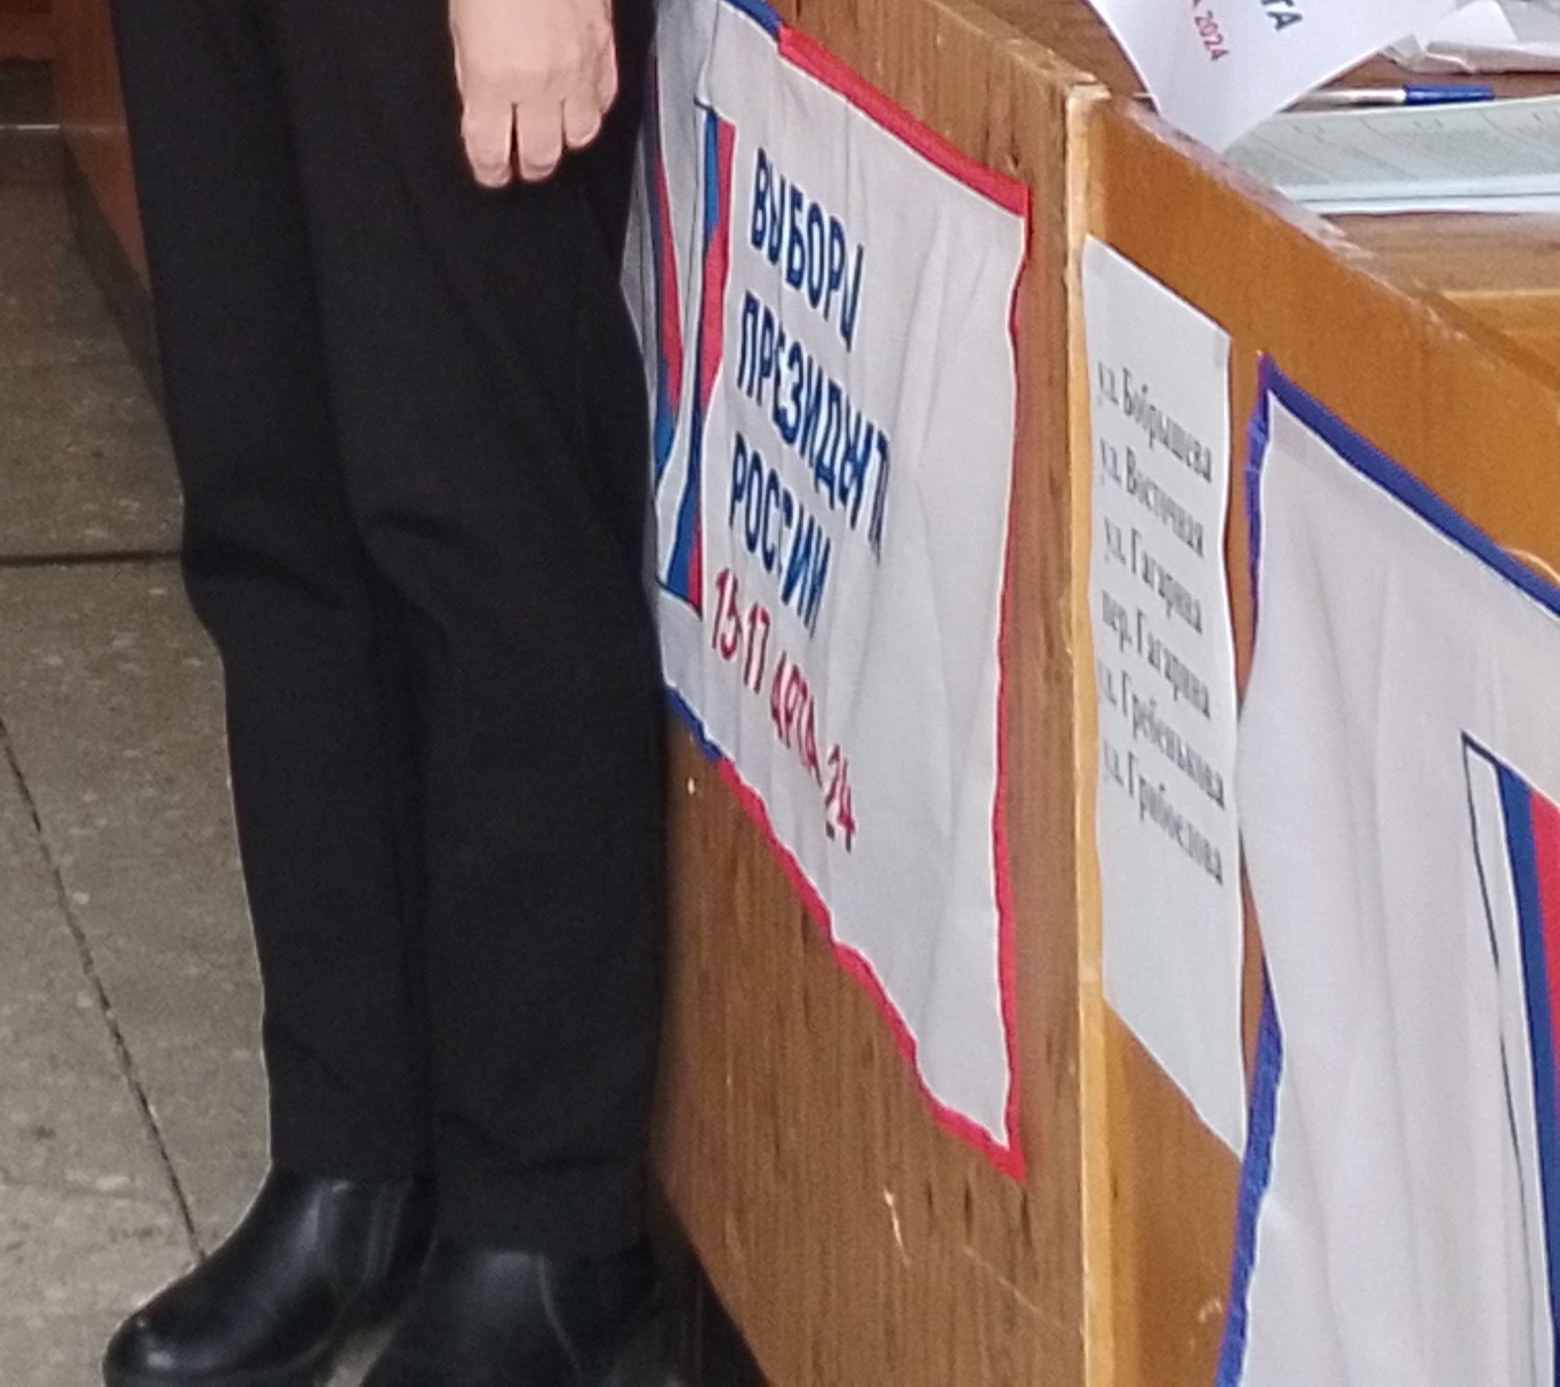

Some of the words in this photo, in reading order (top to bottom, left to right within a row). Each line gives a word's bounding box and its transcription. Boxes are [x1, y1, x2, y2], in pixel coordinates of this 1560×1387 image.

[1195, 10, 1230, 62] 2024
[1131, 527, 1202, 635] Гагарина
[1136, 607, 1211, 721] Гагарина
